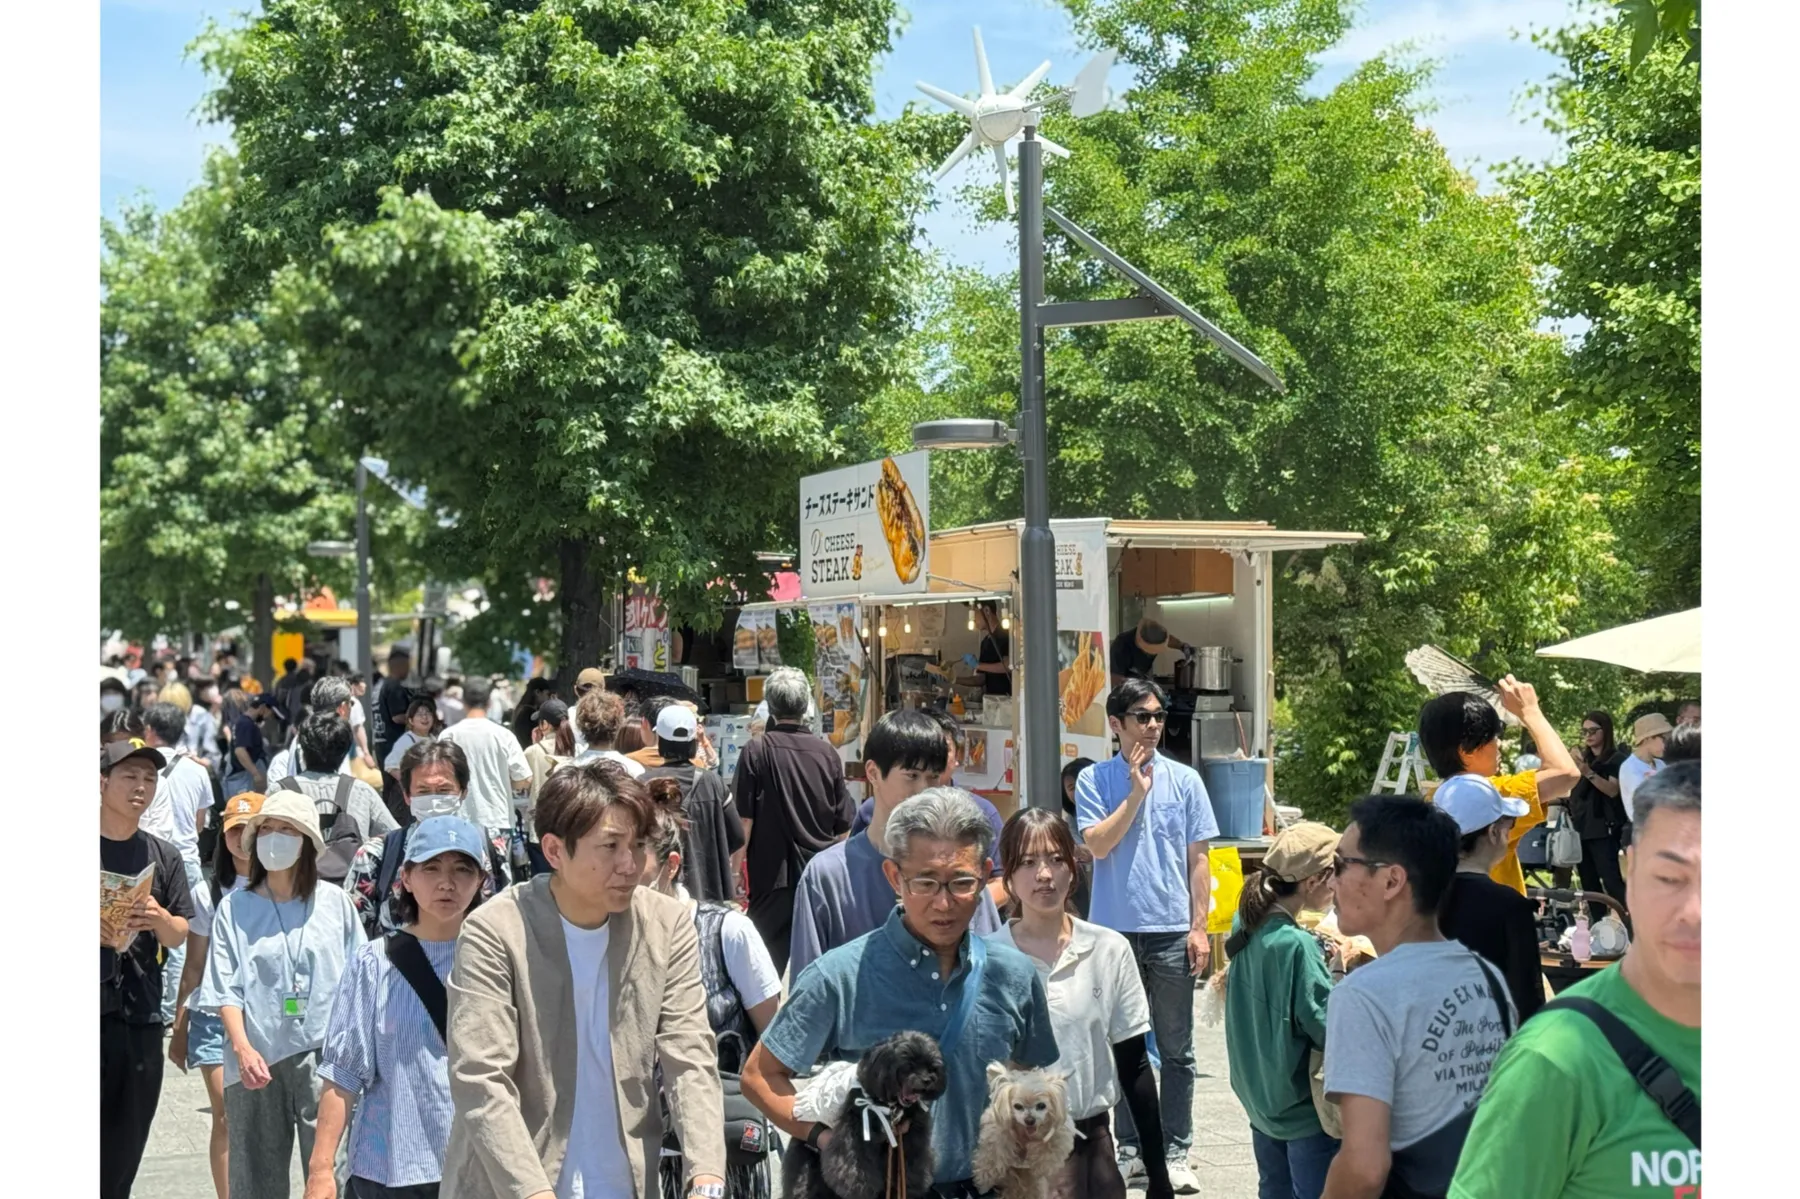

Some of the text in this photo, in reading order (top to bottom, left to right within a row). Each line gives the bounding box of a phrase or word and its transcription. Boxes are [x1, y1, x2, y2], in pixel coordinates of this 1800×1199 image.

[824, 532, 855, 553] CHEESE
[811, 555, 850, 584] STEAK
[1421, 997, 1457, 1053] DEUS
[1453, 984, 1474, 1005] EX
[1453, 1020, 1474, 1037] The
[1438, 1049, 1455, 1063] OF
[1434, 1067, 1456, 1082] VIA
